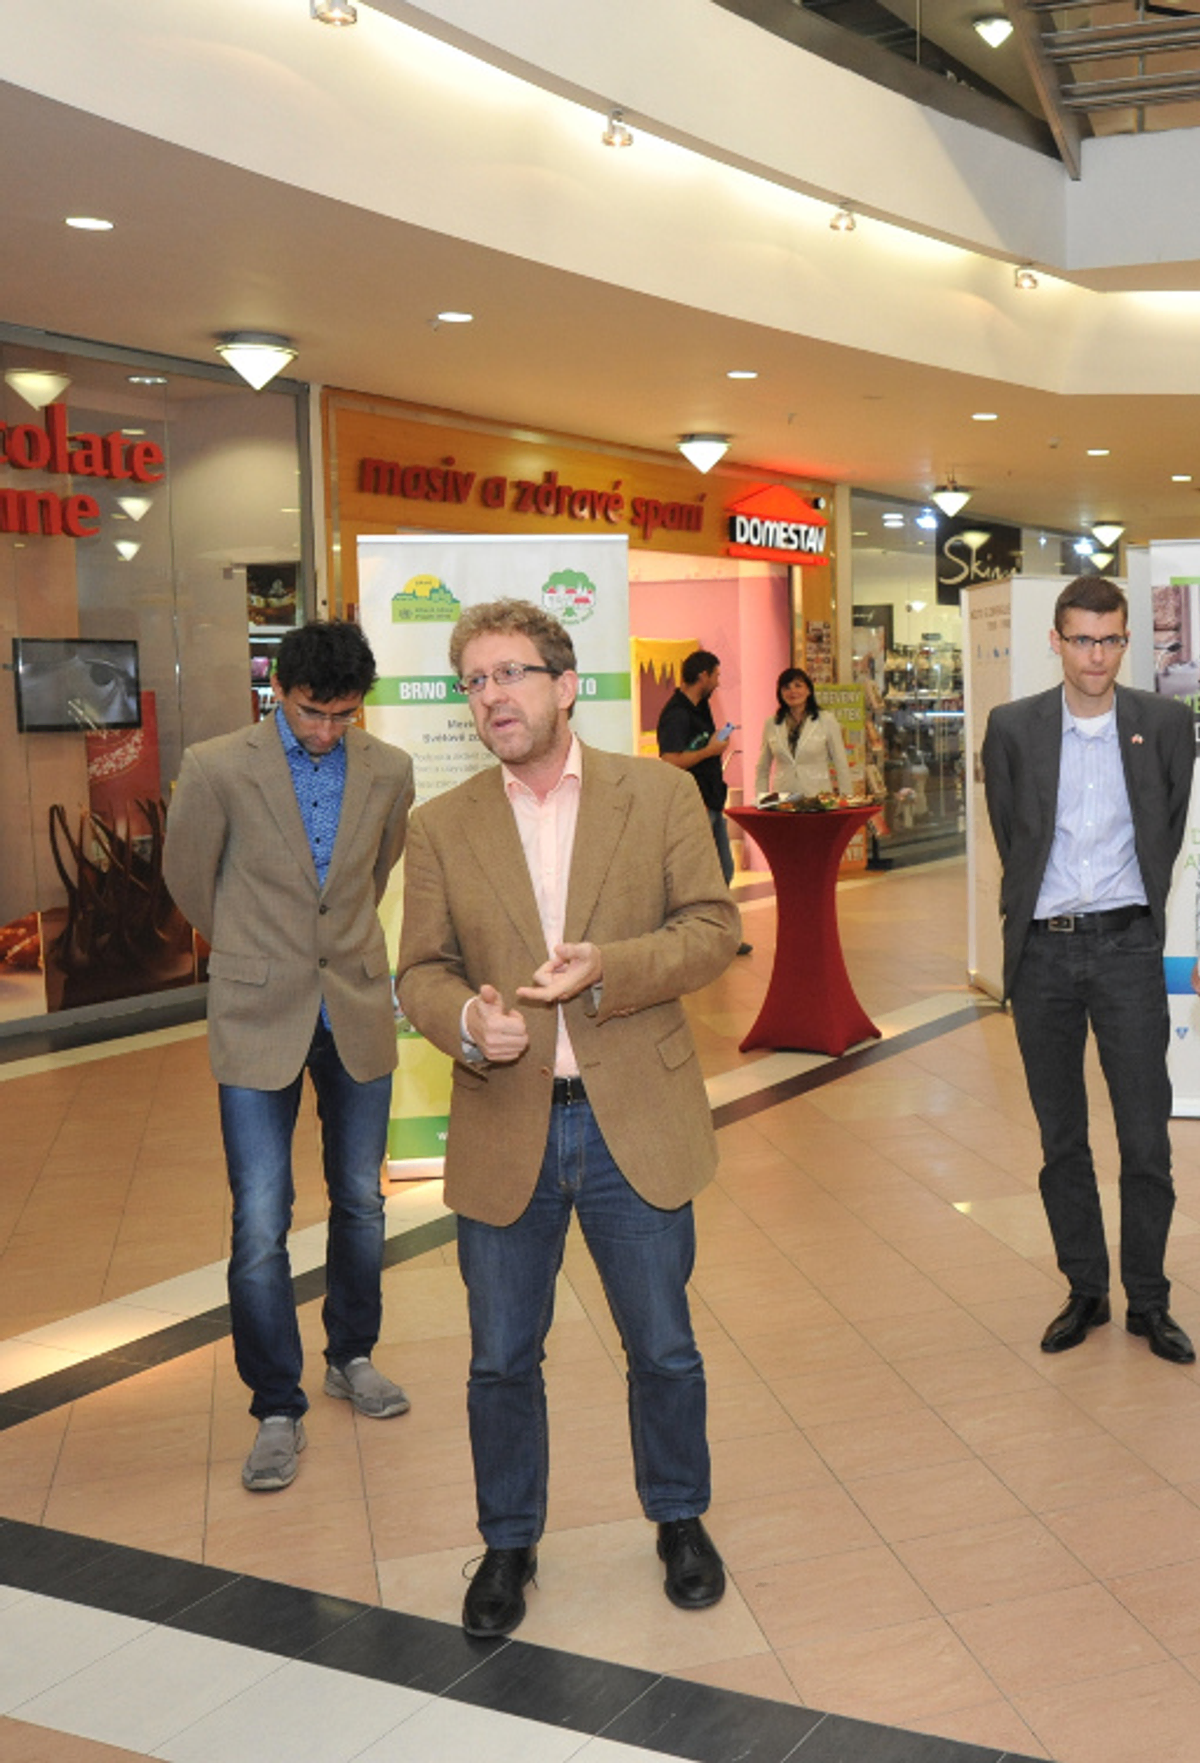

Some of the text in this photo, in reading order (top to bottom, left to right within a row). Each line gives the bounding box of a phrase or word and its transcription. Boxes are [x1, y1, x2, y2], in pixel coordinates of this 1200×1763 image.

[358, 455, 708, 540] masiv a zdravé spaní
[735, 514, 827, 554] DOMESTAV
[399, 682, 447, 700] BRNO
